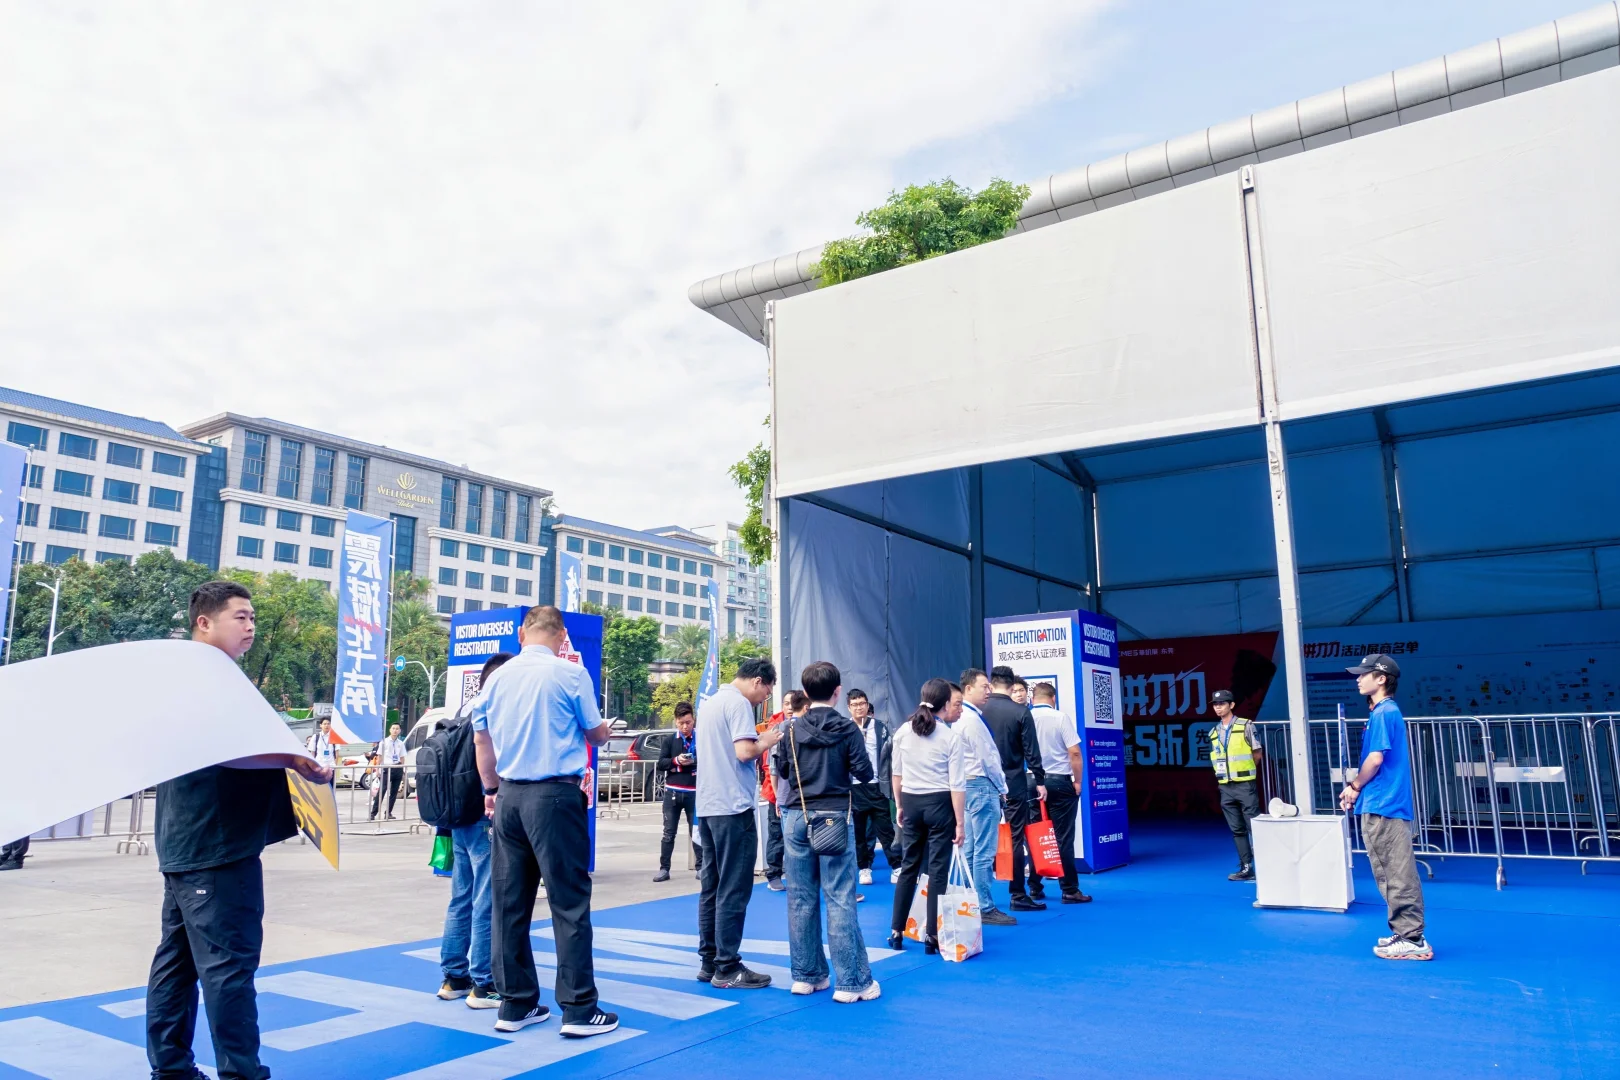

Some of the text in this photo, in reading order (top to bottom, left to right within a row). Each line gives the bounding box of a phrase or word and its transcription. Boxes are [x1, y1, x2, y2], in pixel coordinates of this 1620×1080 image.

[378, 484, 434, 504] WELLGARDEN
[396, 500, 414, 508] Hotel
[478, 620, 514, 638] OVERSEAS
[998, 627, 1066, 646] AUTHENTICATION
[454, 640, 500, 656] REGISTRATION
[998, 648, 1067, 661] 观众实名认证流程
[1084, 640, 1110, 658] REGISTRATION
[1341, 642, 1418, 657] 活动展商名单
[1135, 724, 1183, 766] 5折
